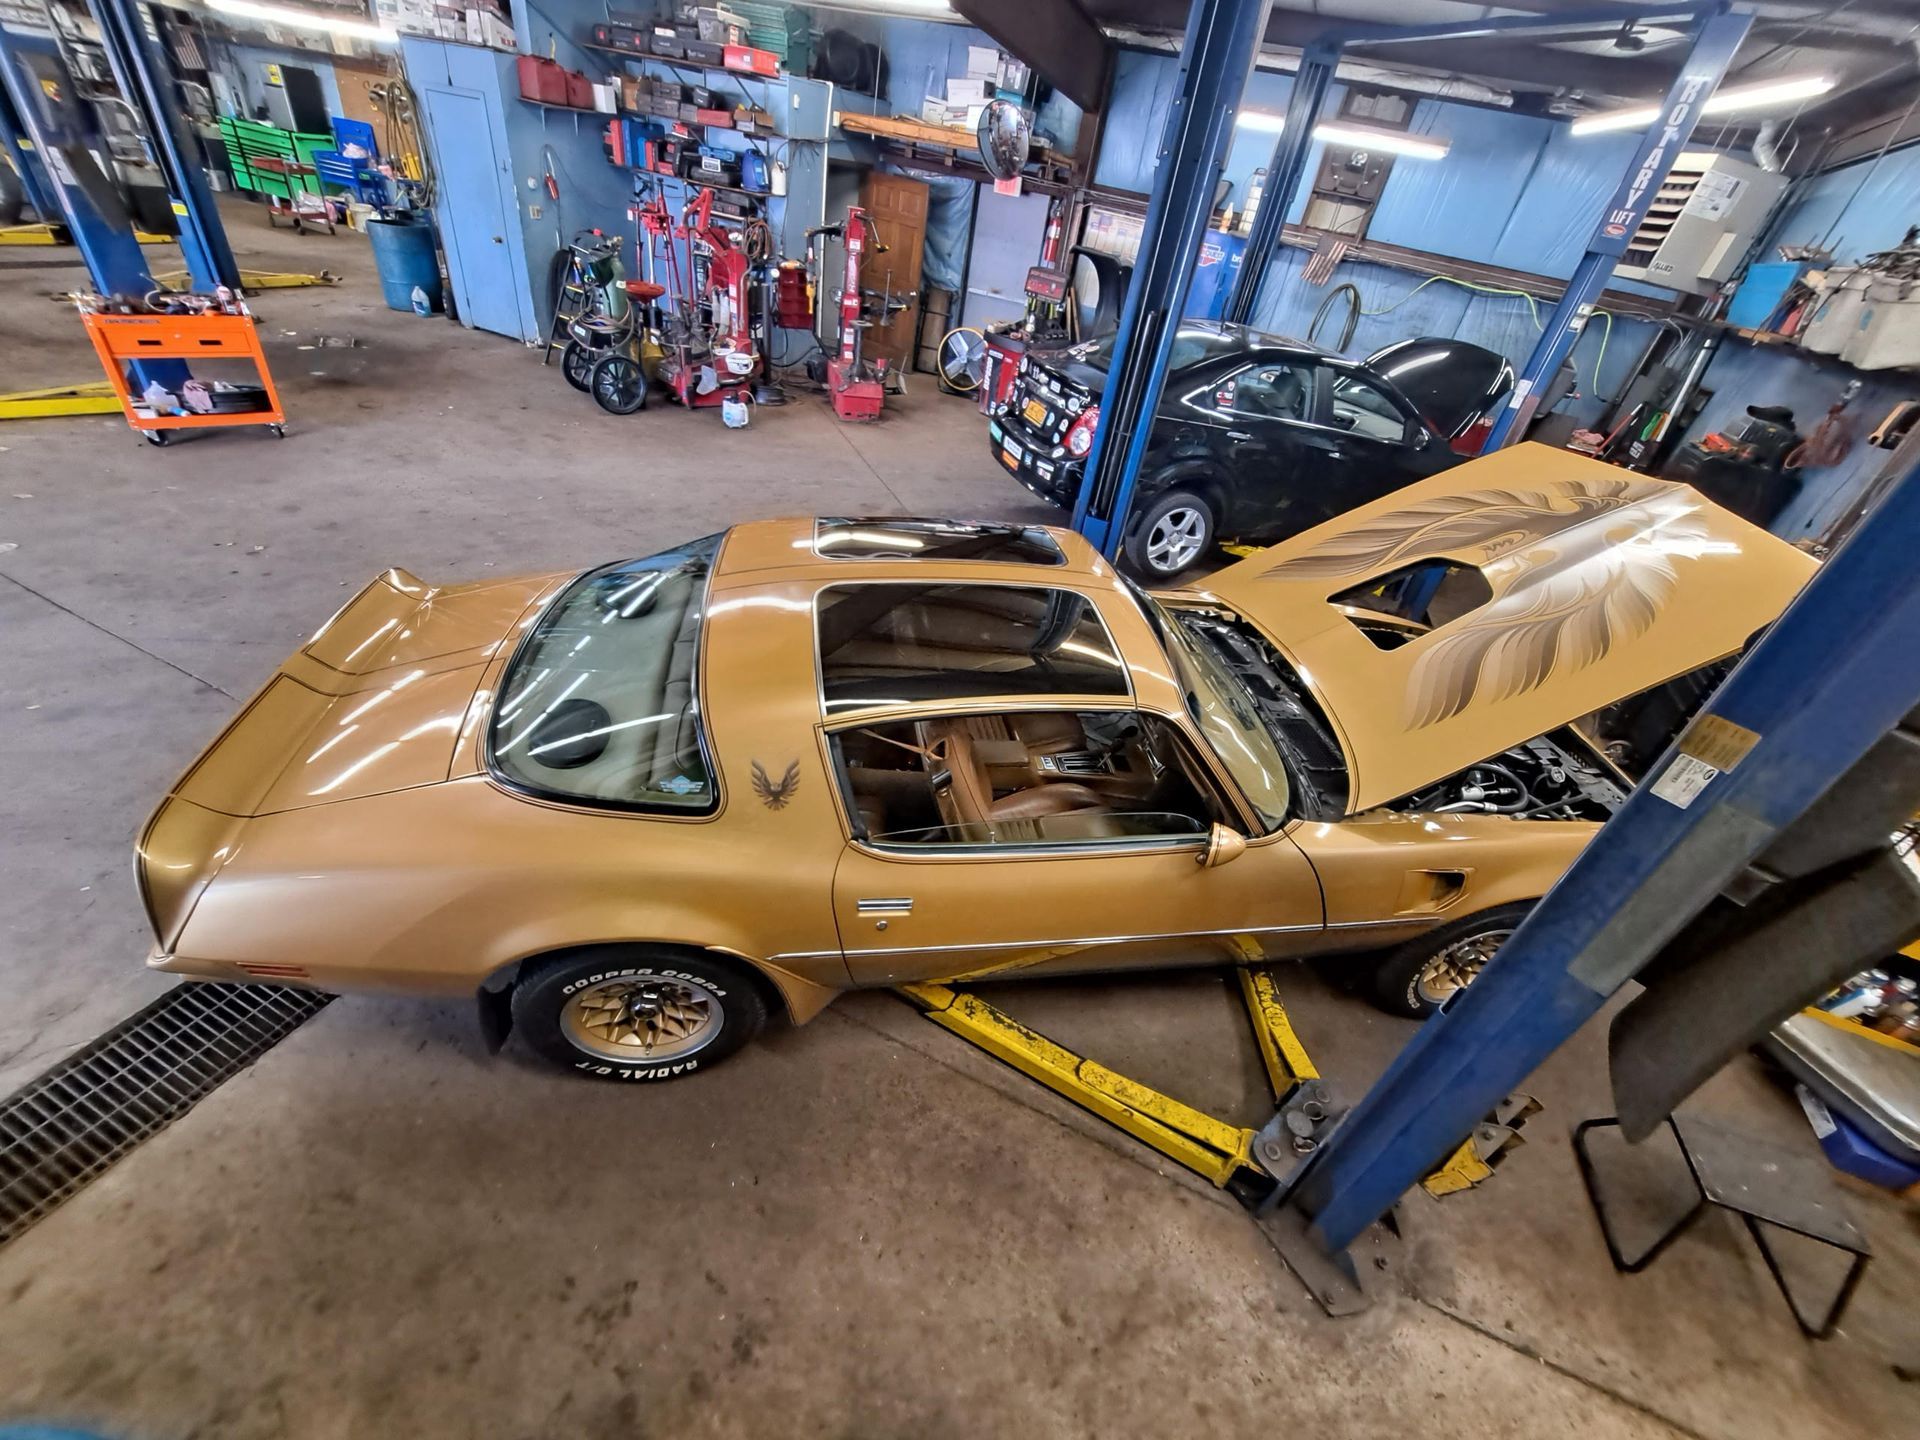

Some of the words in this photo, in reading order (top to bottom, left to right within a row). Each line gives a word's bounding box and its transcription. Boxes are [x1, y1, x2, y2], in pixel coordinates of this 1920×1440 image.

[1625, 78, 1699, 209] ROTARY
[1610, 209, 1636, 225] LIFT
[563, 968, 653, 995] COOPER
[660, 970, 728, 997] COBRA
[620, 1059, 698, 1080] RADIAL
